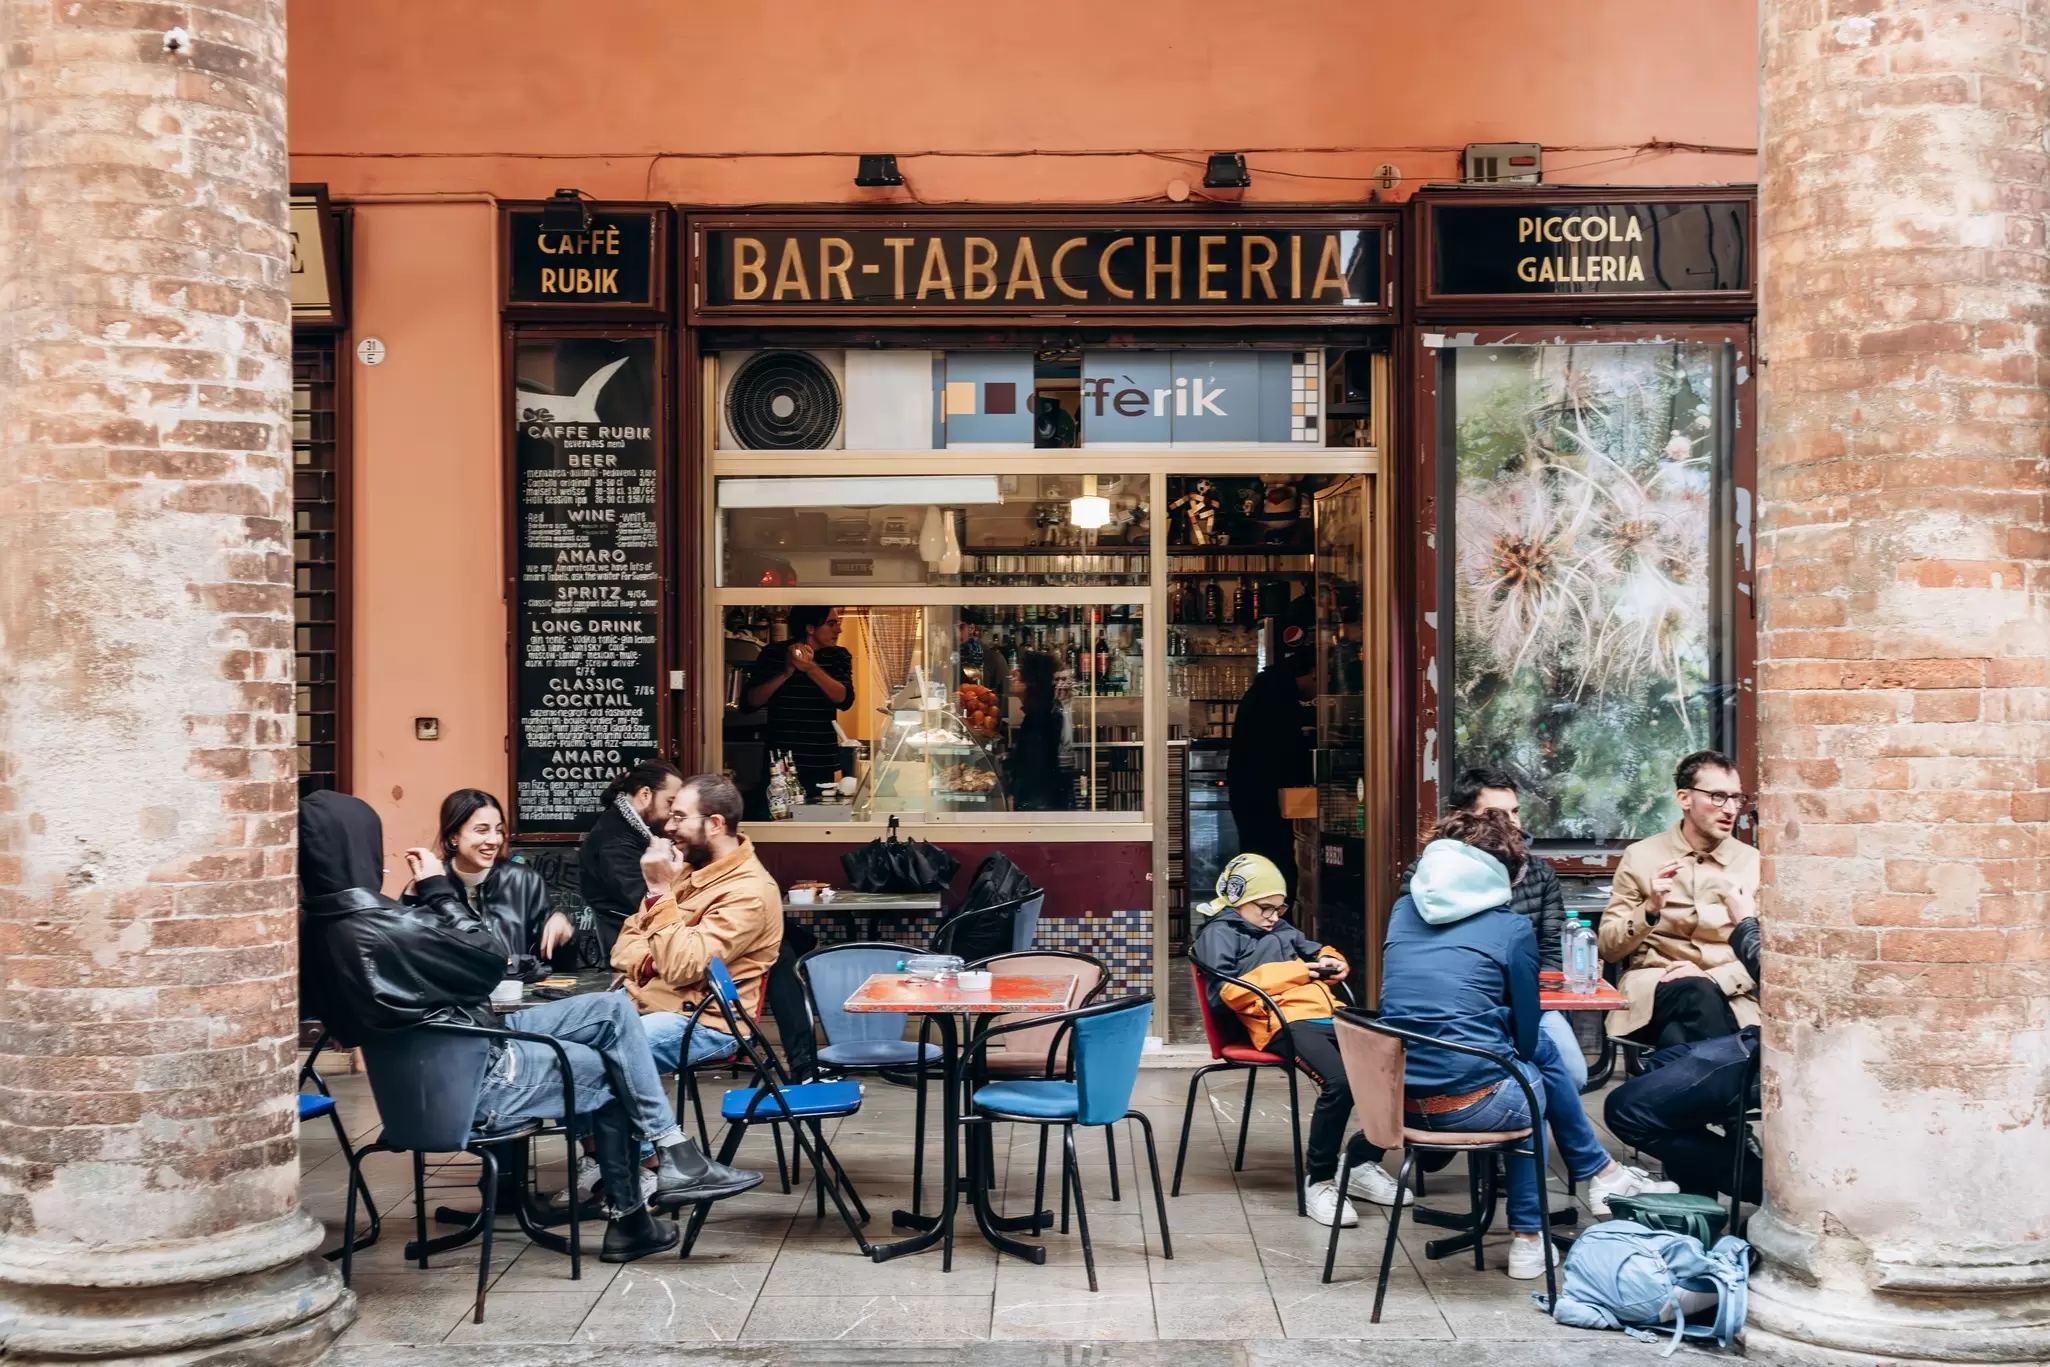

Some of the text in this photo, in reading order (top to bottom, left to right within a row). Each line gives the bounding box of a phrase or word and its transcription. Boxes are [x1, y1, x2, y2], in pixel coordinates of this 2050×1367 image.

[1518, 216, 1643, 242] PICCOLA
[733, 235, 1353, 301] BAR-TABACCHERIA
[1517, 256, 1645, 283] GALLERIA
[541, 268, 619, 294] RUBIK
[599, 426, 652, 440] RUBIK
[569, 454, 618, 468] BEER
[568, 509, 616, 522] WINE
[557, 550, 626, 562] AMARO
[558, 587, 622, 600] SPRITZ
[532, 620, 642, 633] LONG DRINK
[549, 678, 625, 691] CLASSIC
[542, 694, 632, 707] COCKTAIL
[552, 751, 622, 764] AMARO
